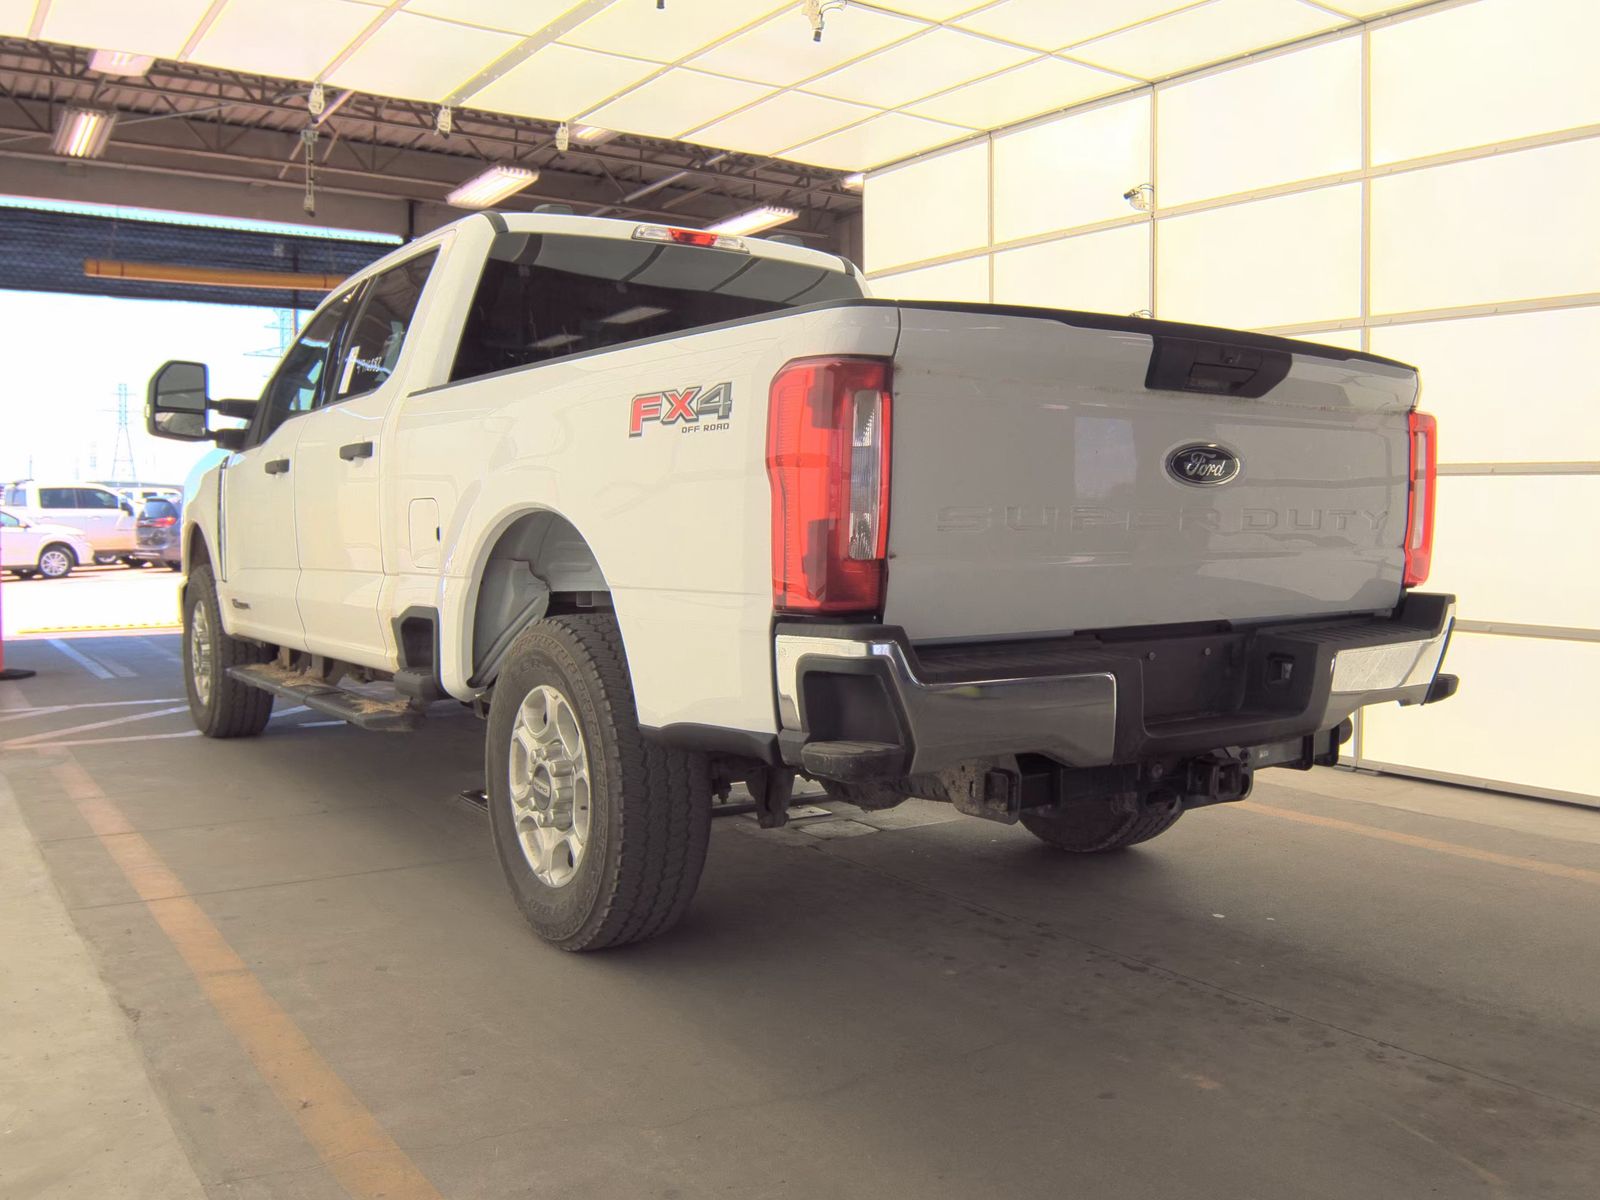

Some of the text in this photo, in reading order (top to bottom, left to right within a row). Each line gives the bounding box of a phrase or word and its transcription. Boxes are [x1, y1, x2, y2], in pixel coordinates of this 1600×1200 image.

[629, 382, 732, 437] FX4
[681, 422, 729, 434] OFF ROAD
[1183, 451, 1226, 477] Ford
[936, 505, 1390, 534] SUPER DUTY
